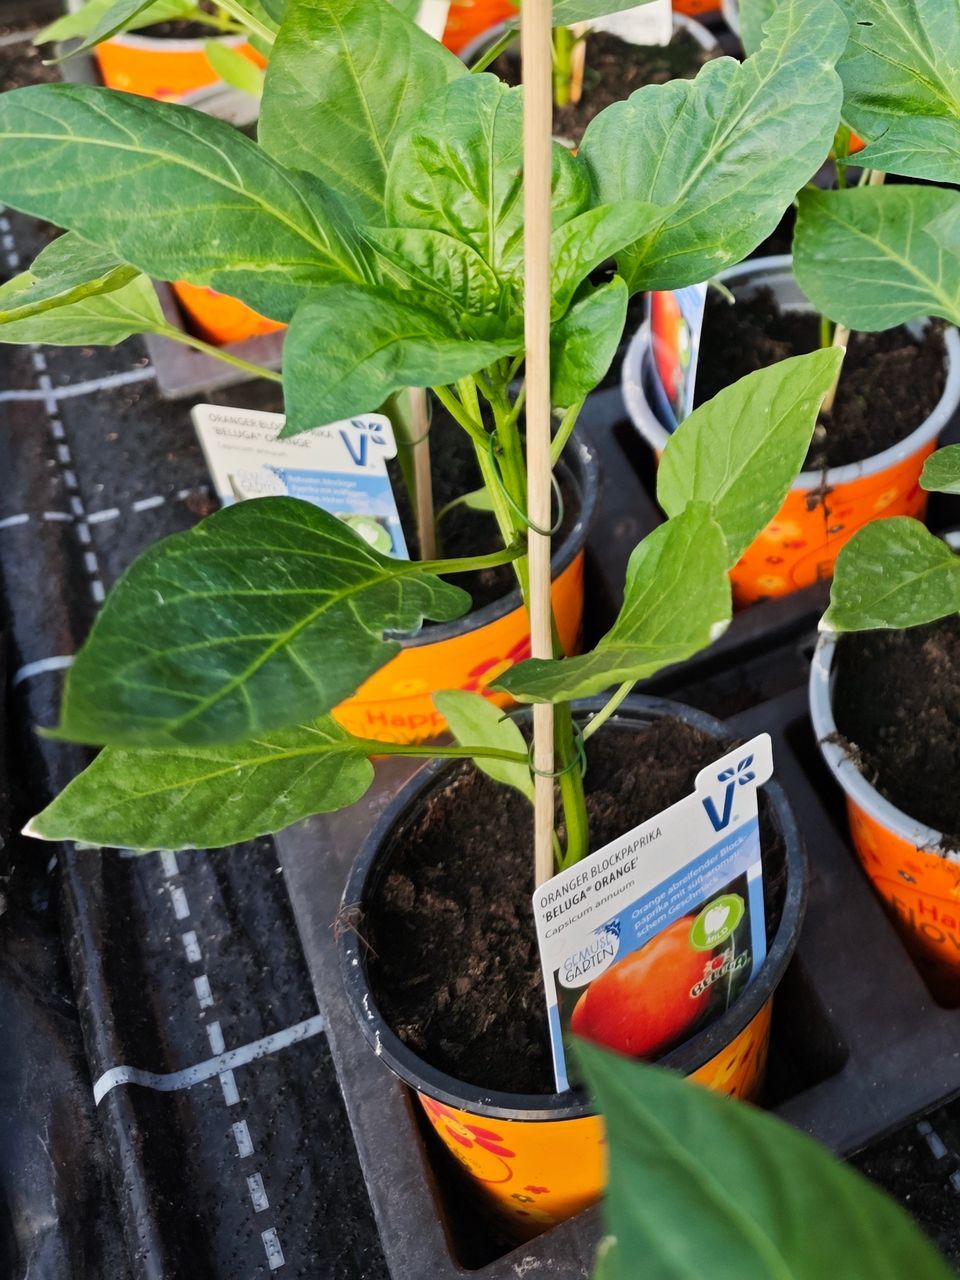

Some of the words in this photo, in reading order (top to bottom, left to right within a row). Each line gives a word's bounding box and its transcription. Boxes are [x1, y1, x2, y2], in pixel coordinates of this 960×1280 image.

[540, 871, 589, 909] ORANGER
[590, 826, 663, 879] BLOCKPAPRIKA
[631, 892, 667, 920] Orange
[667, 853, 719, 894] abreifender
[545, 905, 593, 939] Capsicum
[594, 879, 636, 908] annuum
[634, 900, 669, 931] paprika
[670, 889, 686, 904] mit
[636, 914, 668, 938] schem
[706, 926, 729, 945] MILD
[565, 944, 614, 983] GARTEN
